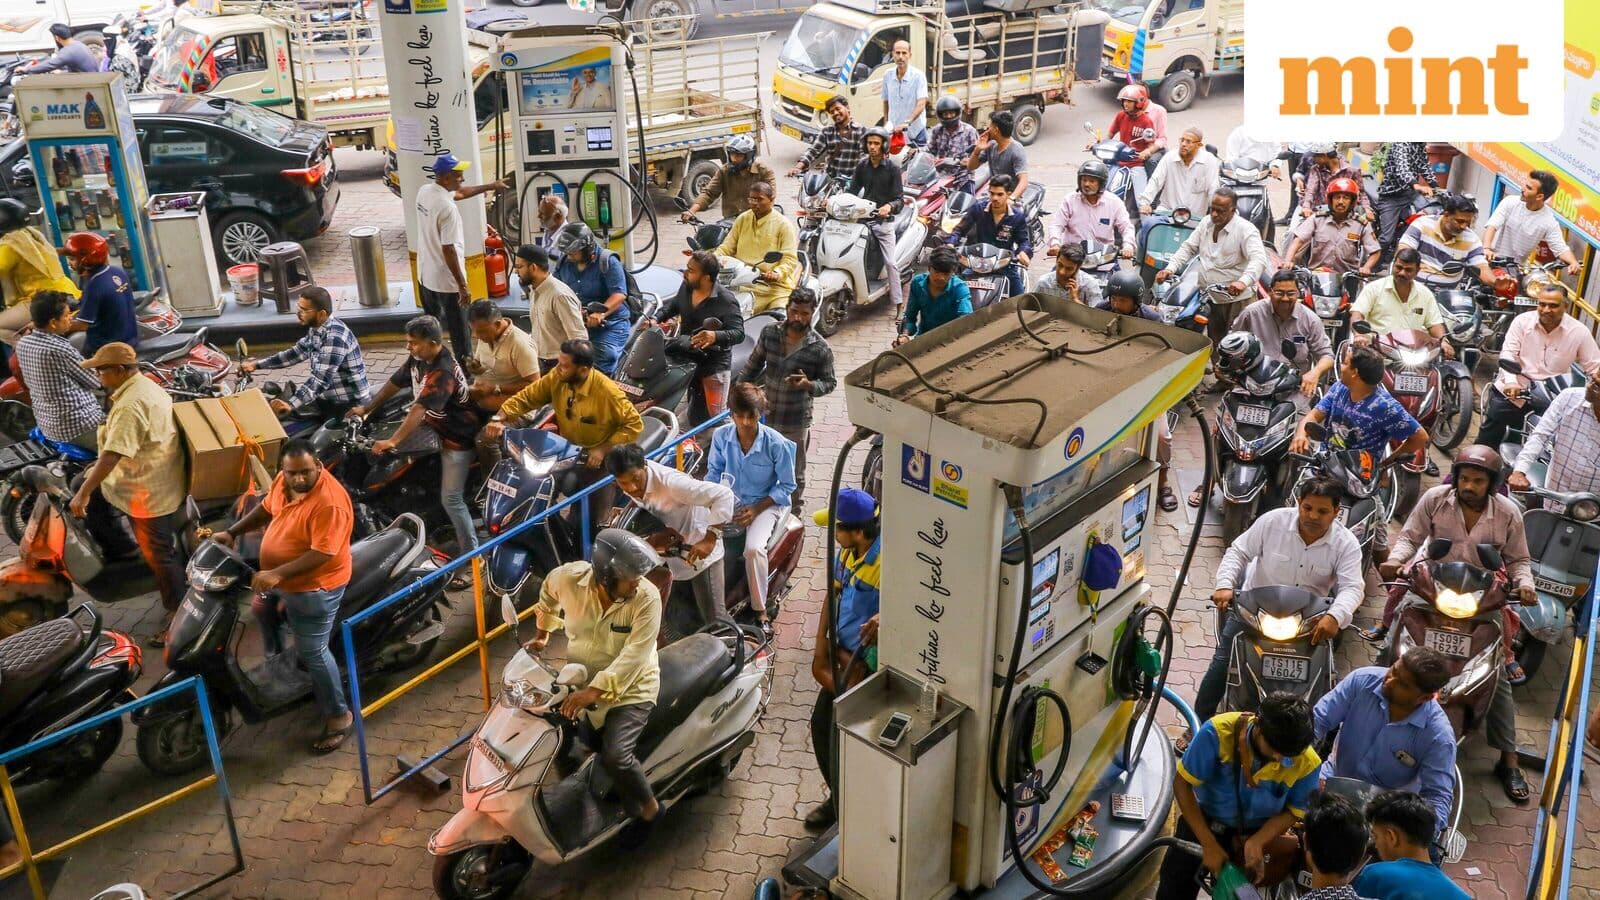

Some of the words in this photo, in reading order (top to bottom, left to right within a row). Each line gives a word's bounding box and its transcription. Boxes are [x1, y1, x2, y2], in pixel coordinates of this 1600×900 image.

[408, 56, 443, 89] feel
[46, 103, 80, 114] MAK
[414, 91, 440, 109] ko
[423, 115, 451, 156] future
[935, 486, 968, 503] Petroleum
[940, 482, 961, 496] Bharat
[915, 551, 951, 597] feel
[914, 600, 945, 623] ko
[1432, 632, 1466, 646] TS09F
[916, 629, 947, 684] future
[1271, 657, 1303, 670] TS11E
